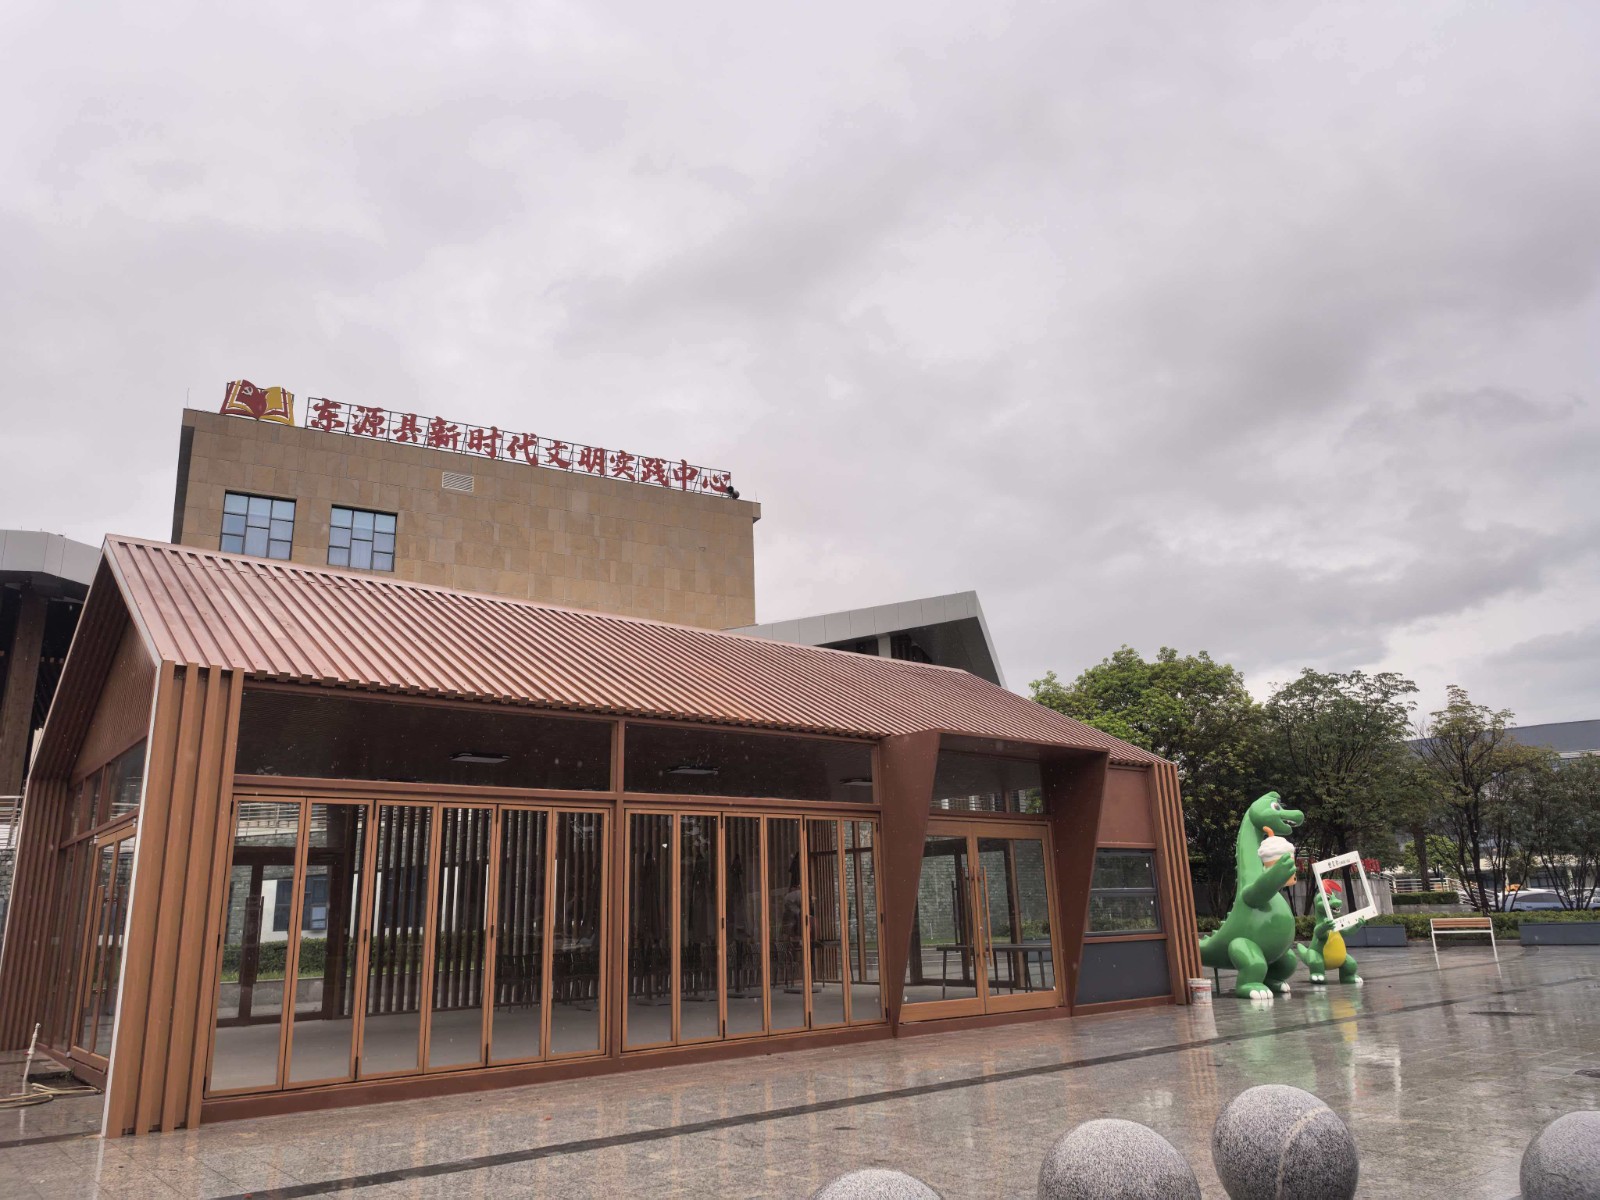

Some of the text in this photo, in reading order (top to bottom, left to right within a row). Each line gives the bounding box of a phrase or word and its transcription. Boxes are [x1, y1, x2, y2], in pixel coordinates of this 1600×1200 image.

[310, 398, 731, 493] 东源县新时代文明实践中心
